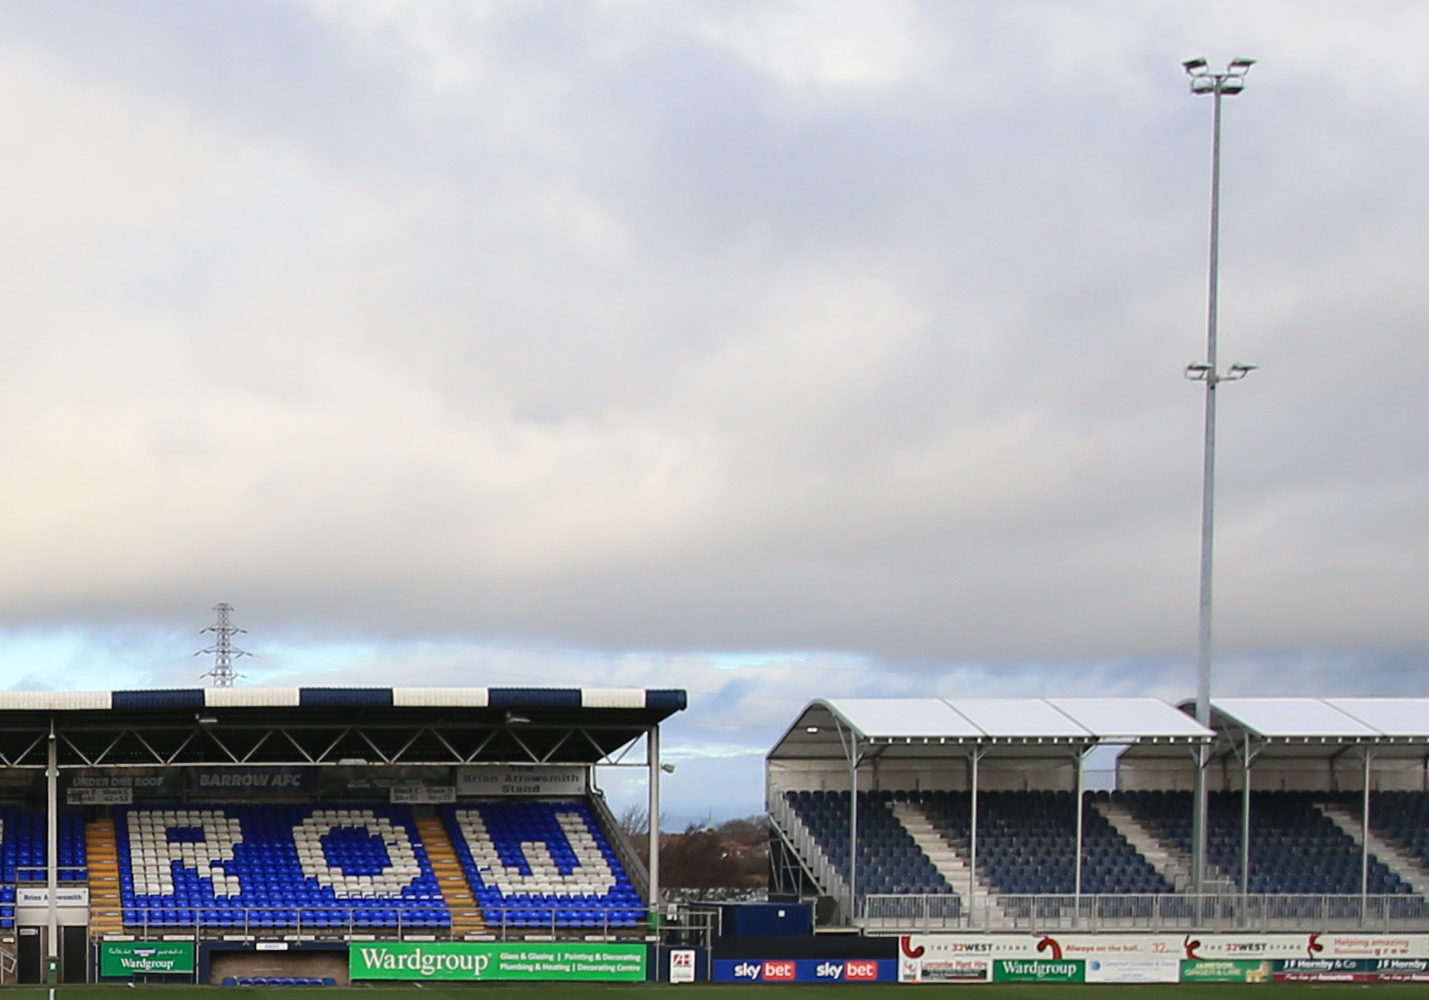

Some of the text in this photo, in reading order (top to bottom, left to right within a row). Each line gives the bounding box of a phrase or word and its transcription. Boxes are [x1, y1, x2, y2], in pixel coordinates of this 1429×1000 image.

[72, 777, 164, 787] UNDER ONE ROOF
[200, 774, 302, 786] BARROW AFC
[463, 774, 579, 783] Brian Arrowsmith
[501, 784, 540, 793] Stand
[951, 943, 993, 952] 32WEST
[1225, 943, 1267, 951] 32WEST
[1334, 938, 1410, 948] Helping amazing
[1065, 944, 1094, 953] Always
[1107, 944, 1122, 952] the
[360, 948, 491, 975] Wardgroup
[499, 952, 642, 962] Glass & Glazing Painting & Decorating
[120, 958, 175, 970] Wardgroup
[499, 963, 641, 973] Plumbing & Heating Decorating Centre
[1284, 960, 1356, 970] J F Hornby & Co
[1377, 960, 1427, 970] J F Hornby
[734, 961, 792, 980] sky bet
[816, 961, 873, 980] sky bet
[1002, 961, 1077, 978] Wardgroup
